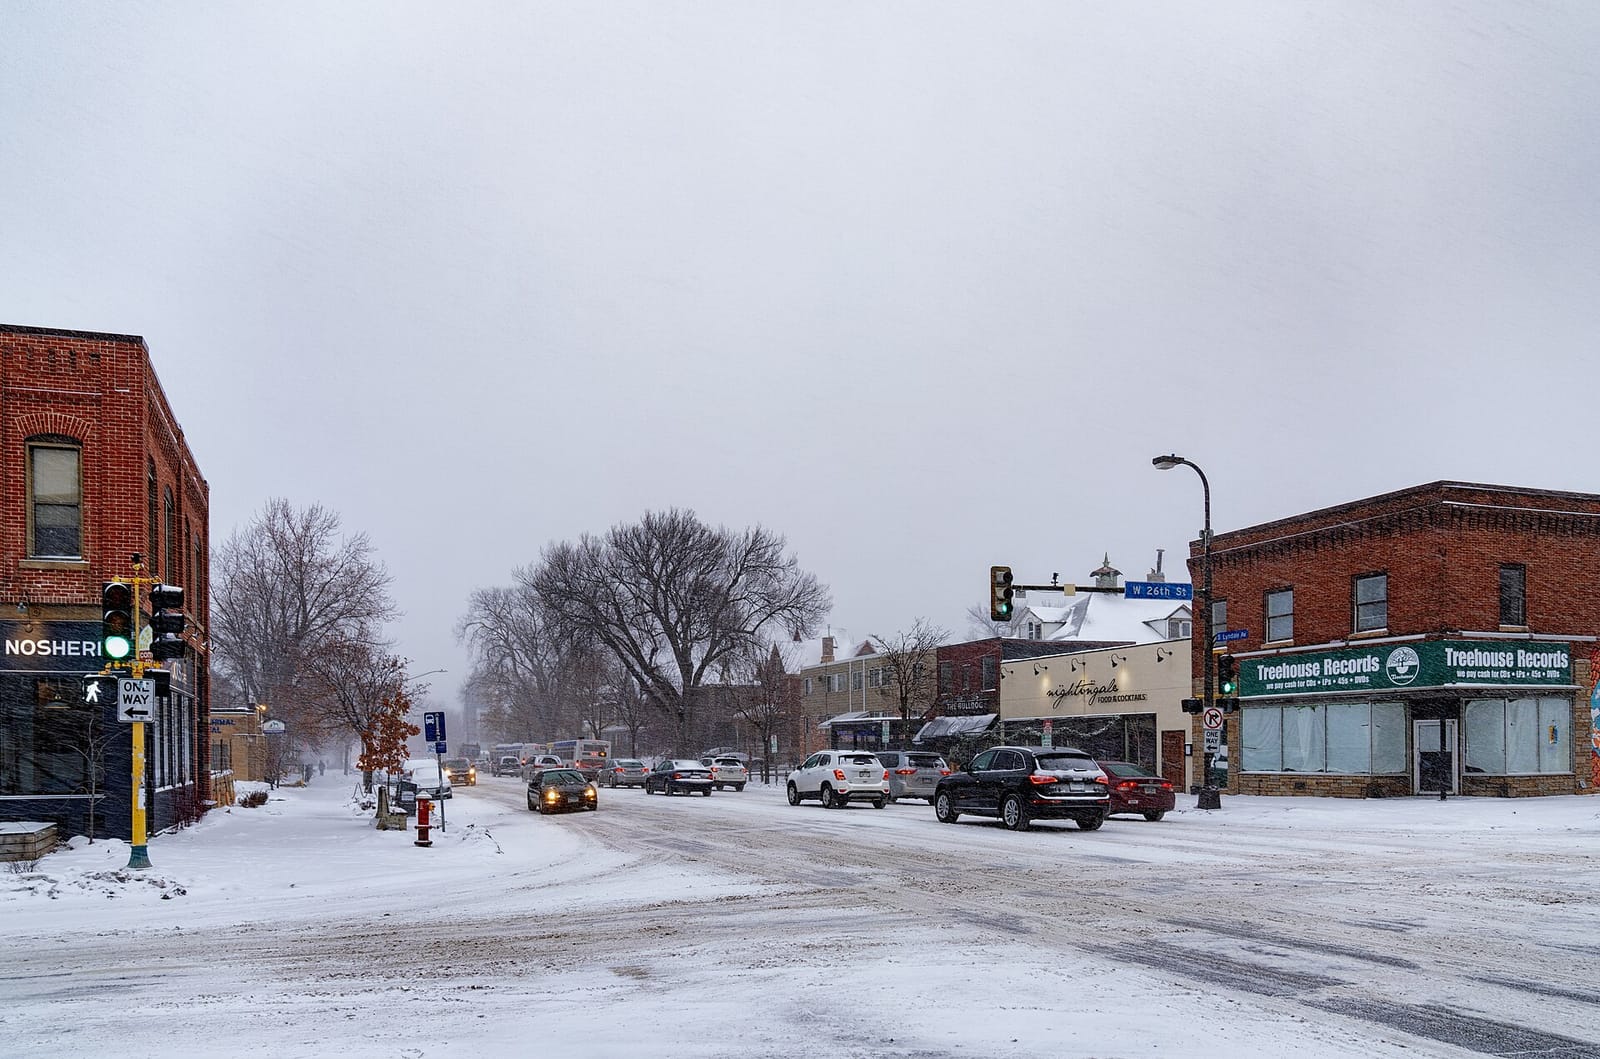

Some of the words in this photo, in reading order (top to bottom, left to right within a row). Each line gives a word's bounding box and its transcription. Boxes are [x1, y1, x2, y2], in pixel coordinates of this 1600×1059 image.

[1133, 585, 1141, 595] W
[1146, 586, 1170, 596] 26th
[1176, 587, 1187, 597] St
[5, 639, 102, 657] NOSHERI
[1445, 648, 1514, 667] Treehouse
[1517, 650, 1569, 668] Records
[1257, 661, 1321, 681] Treehouse
[1323, 654, 1380, 676] Records
[1456, 670, 1466, 678] we
[1466, 670, 1477, 679] pay
[1477, 670, 1490, 678] cash
[1491, 670, 1500, 678] for
[1500, 670, 1511, 678] CDs
[1516, 670, 1526, 678] LPs
[1531, 670, 1542, 678] 45s
[1546, 670, 1560, 678] DVDs
[123, 681, 150, 693] ONE
[1274, 682, 1284, 690] pay
[1284, 681, 1297, 689] cash
[1297, 680, 1306, 688] for
[1306, 679, 1317, 687] CDs
[1322, 678, 1331, 686] LPs
[1337, 677, 1349, 685] 45s
[1354, 675, 1369, 684] DVDs
[122, 694, 150, 705] WAY
[1097, 695, 1113, 703] FOOD
[1117, 693, 1147, 703] COCKTAILS
[958, 701, 984, 710] BULLDOG
